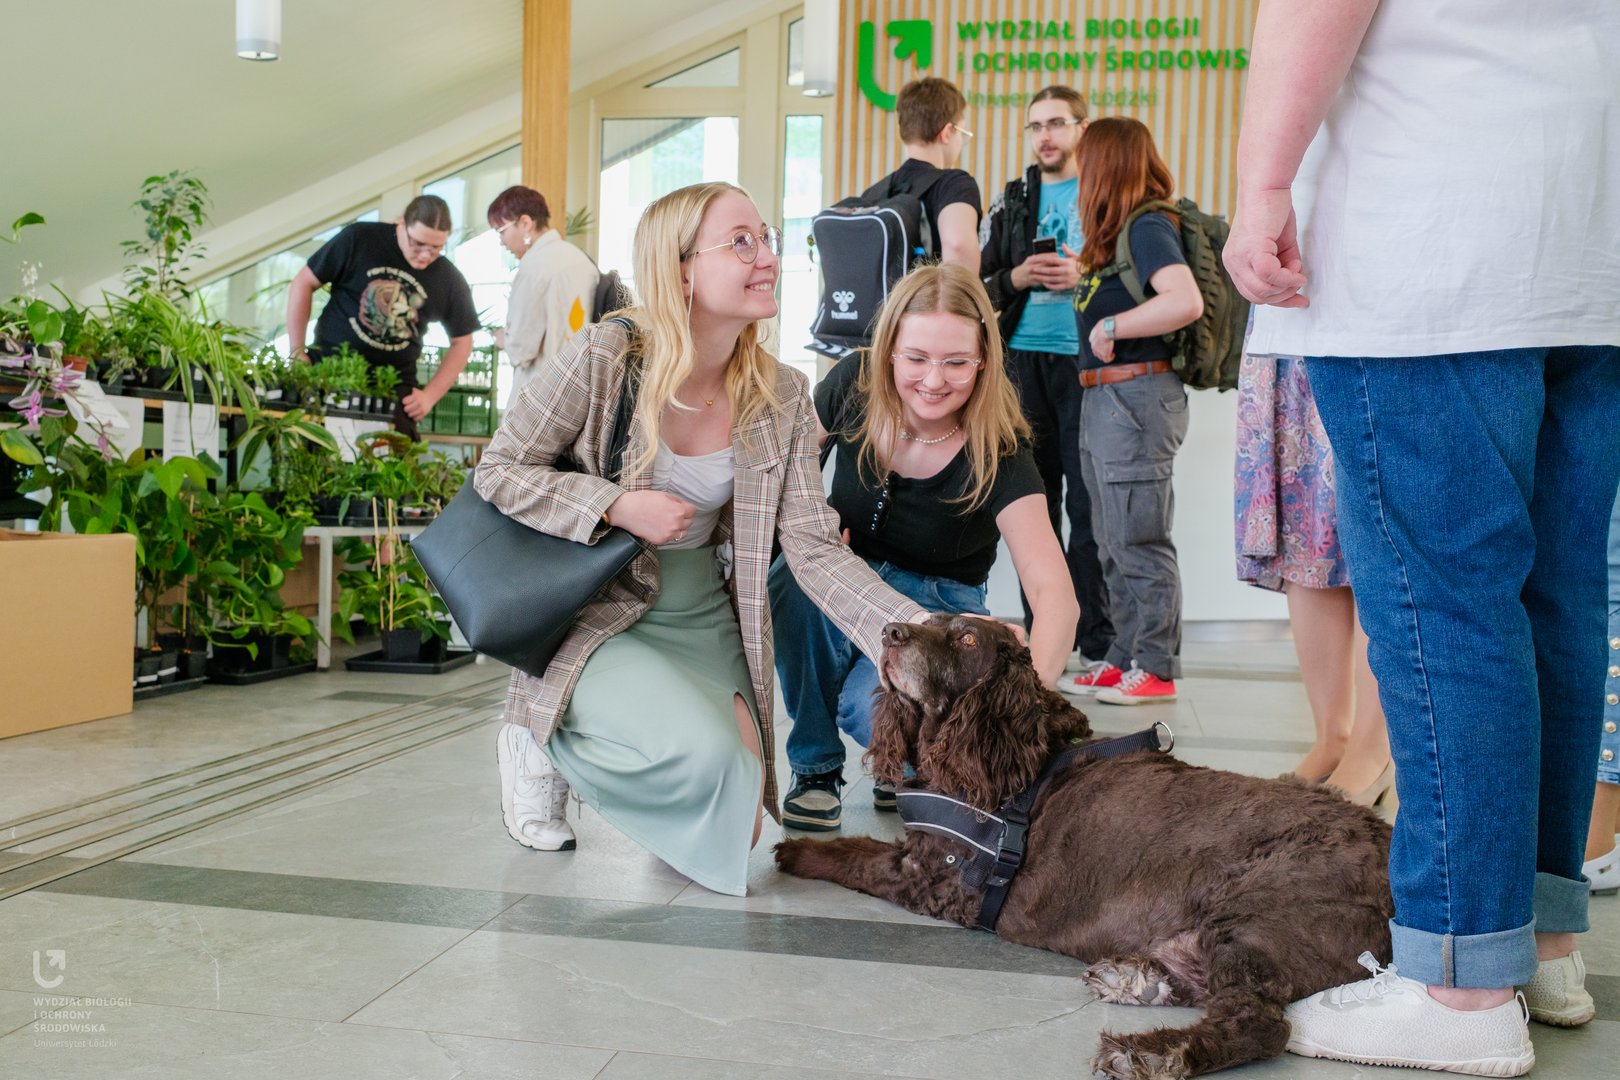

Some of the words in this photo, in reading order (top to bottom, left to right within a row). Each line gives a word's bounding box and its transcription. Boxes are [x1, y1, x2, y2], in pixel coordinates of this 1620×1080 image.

[957, 20, 1075, 40] WYDZIAŁ
[1085, 17, 1199, 39] BIOLOGII
[972, 51, 1098, 73] OCHRONY
[1105, 45, 1248, 72] ŚRODOWIS
